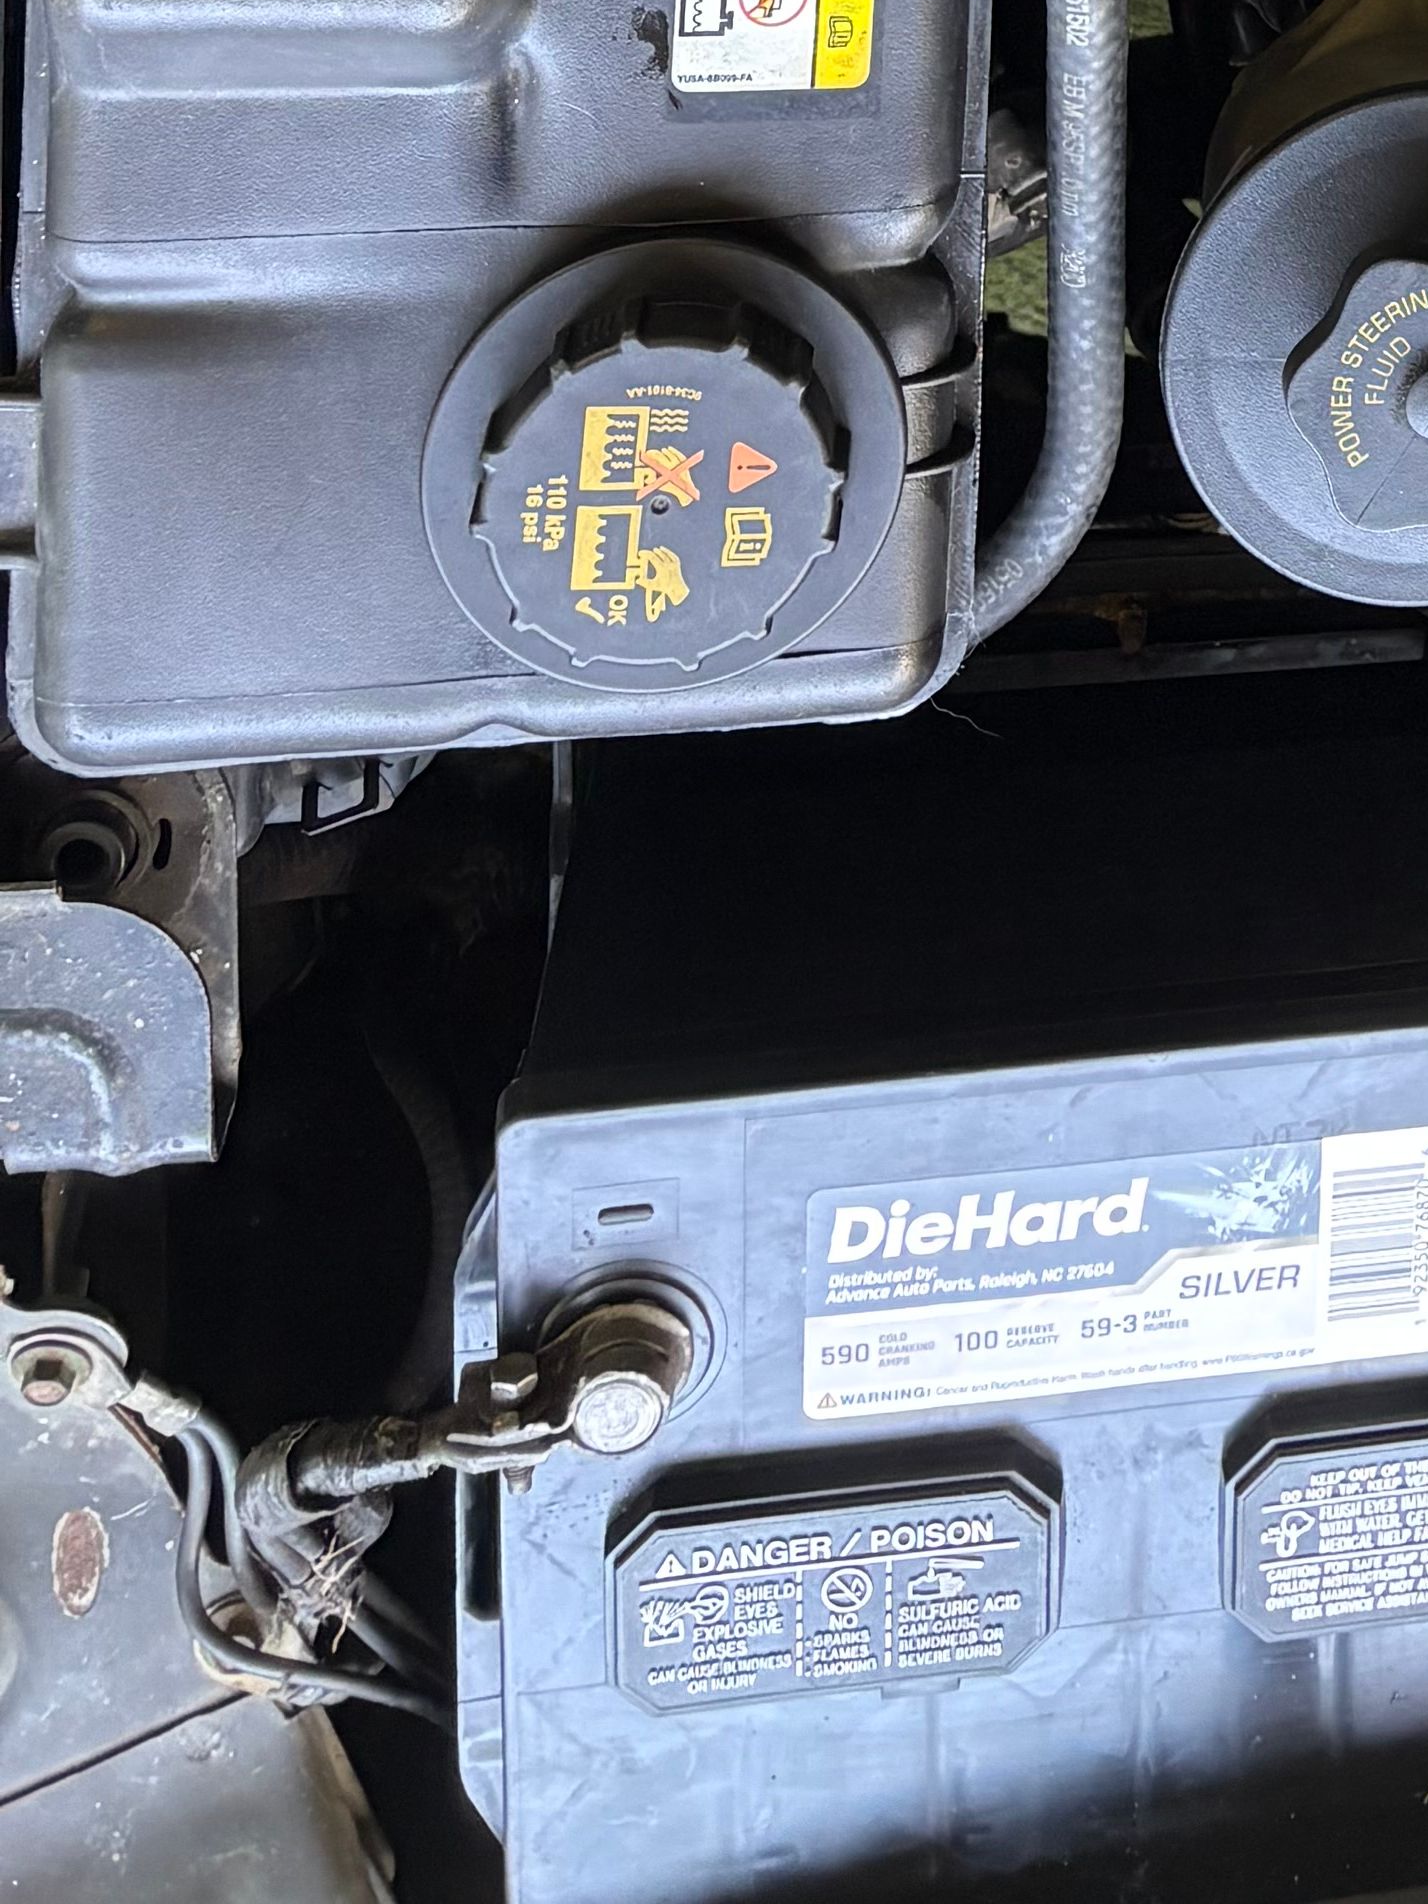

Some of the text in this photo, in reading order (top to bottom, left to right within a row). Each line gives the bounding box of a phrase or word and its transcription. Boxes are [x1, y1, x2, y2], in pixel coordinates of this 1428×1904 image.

[1364, 336, 1411, 405] FLUID
[1330, 375, 1369, 468] POWER
[520, 485, 543, 543] 16 psi
[542, 475, 568, 551] 110 kPa
[607, 594, 628, 626] OK
[827, 1177, 1149, 1264] DieHard
[825, 1286, 890, 1305] Advance
[893, 1283, 930, 1298] Auto
[979, 1269, 1038, 1290] Raleigh,
[1041, 1268, 1063, 1282] NC
[1067, 1261, 1114, 1280] 27604
[829, 1266, 913, 1287] Distributed
[1178, 1264, 1301, 1300] SILVER
[1144, 1309, 1171, 1321] PART
[878, 1332, 908, 1344] COLD
[1081, 1314, 1138, 1340] 59-3
[878, 1341, 935, 1356] CRANKING
[955, 1330, 999, 1353] 100
[1006, 1335, 1059, 1349] CAPACITY
[821, 1343, 870, 1366] 590
[1363, 1497, 1398, 1515] EYES
[691, 1535, 832, 1575] DANGER
[871, 1518, 994, 1553] POISON
[1318, 1535, 1375, 1554] MEDICAL
[734, 1583, 796, 1603] SHIELD
[734, 1601, 777, 1620] EYES
[898, 1593, 1021, 1622] SULFURIC ACID
[692, 1619, 783, 1642] EXPLOSIVE
[828, 1613, 858, 1631] NO
[898, 1623, 928, 1637] CAN
[692, 1640, 748, 1662] GASES
[648, 1669, 676, 1685] CAN
